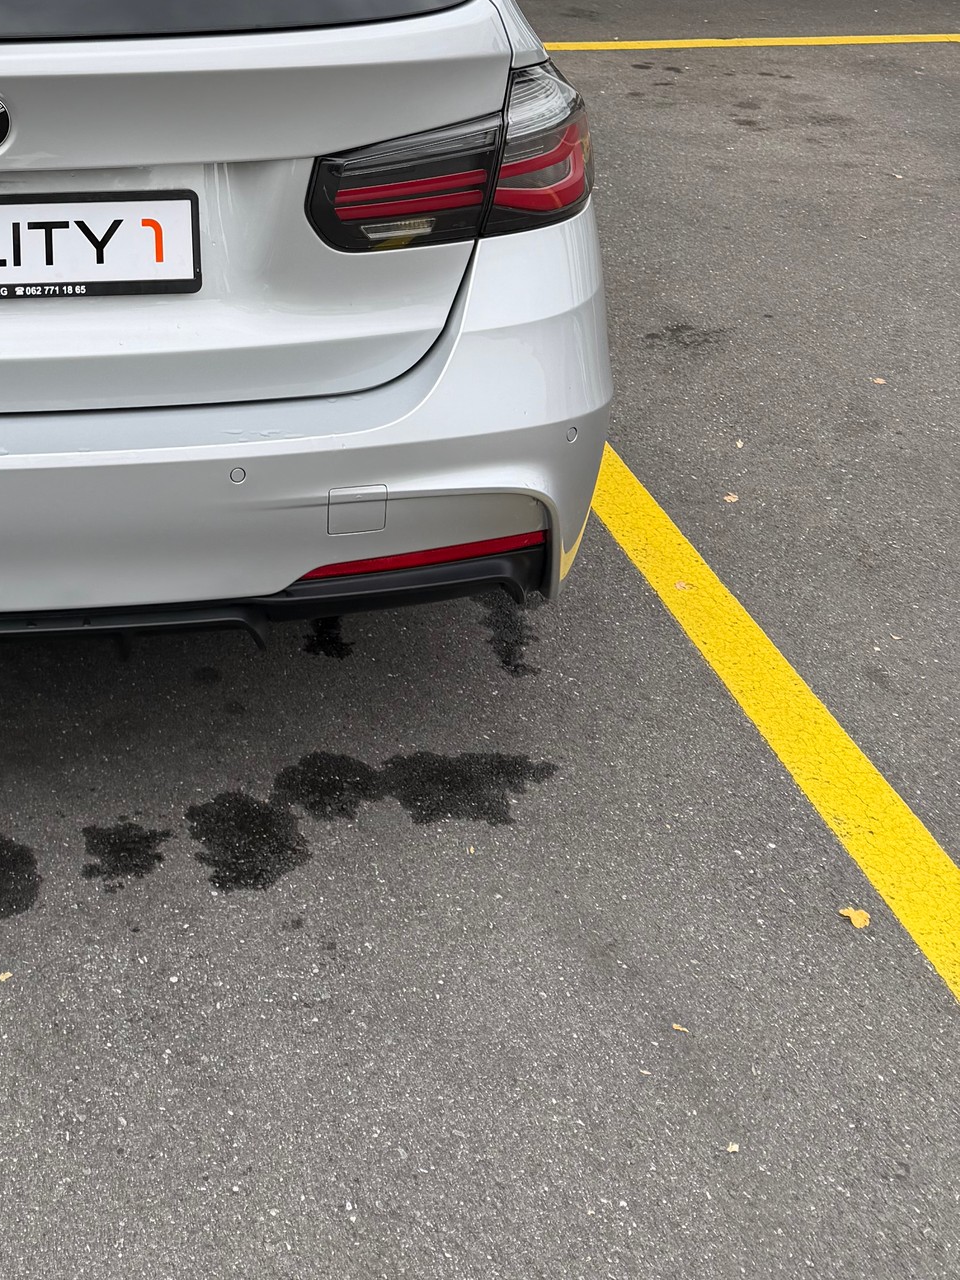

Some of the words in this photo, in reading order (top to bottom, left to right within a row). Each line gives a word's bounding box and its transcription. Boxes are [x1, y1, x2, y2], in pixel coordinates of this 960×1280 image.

[141, 218, 164, 263] 1
[26, 286, 42, 295] 062
[43, 286, 60, 295] 771
[62, 286, 73, 295] 18
[74, 285, 87, 294] 65
